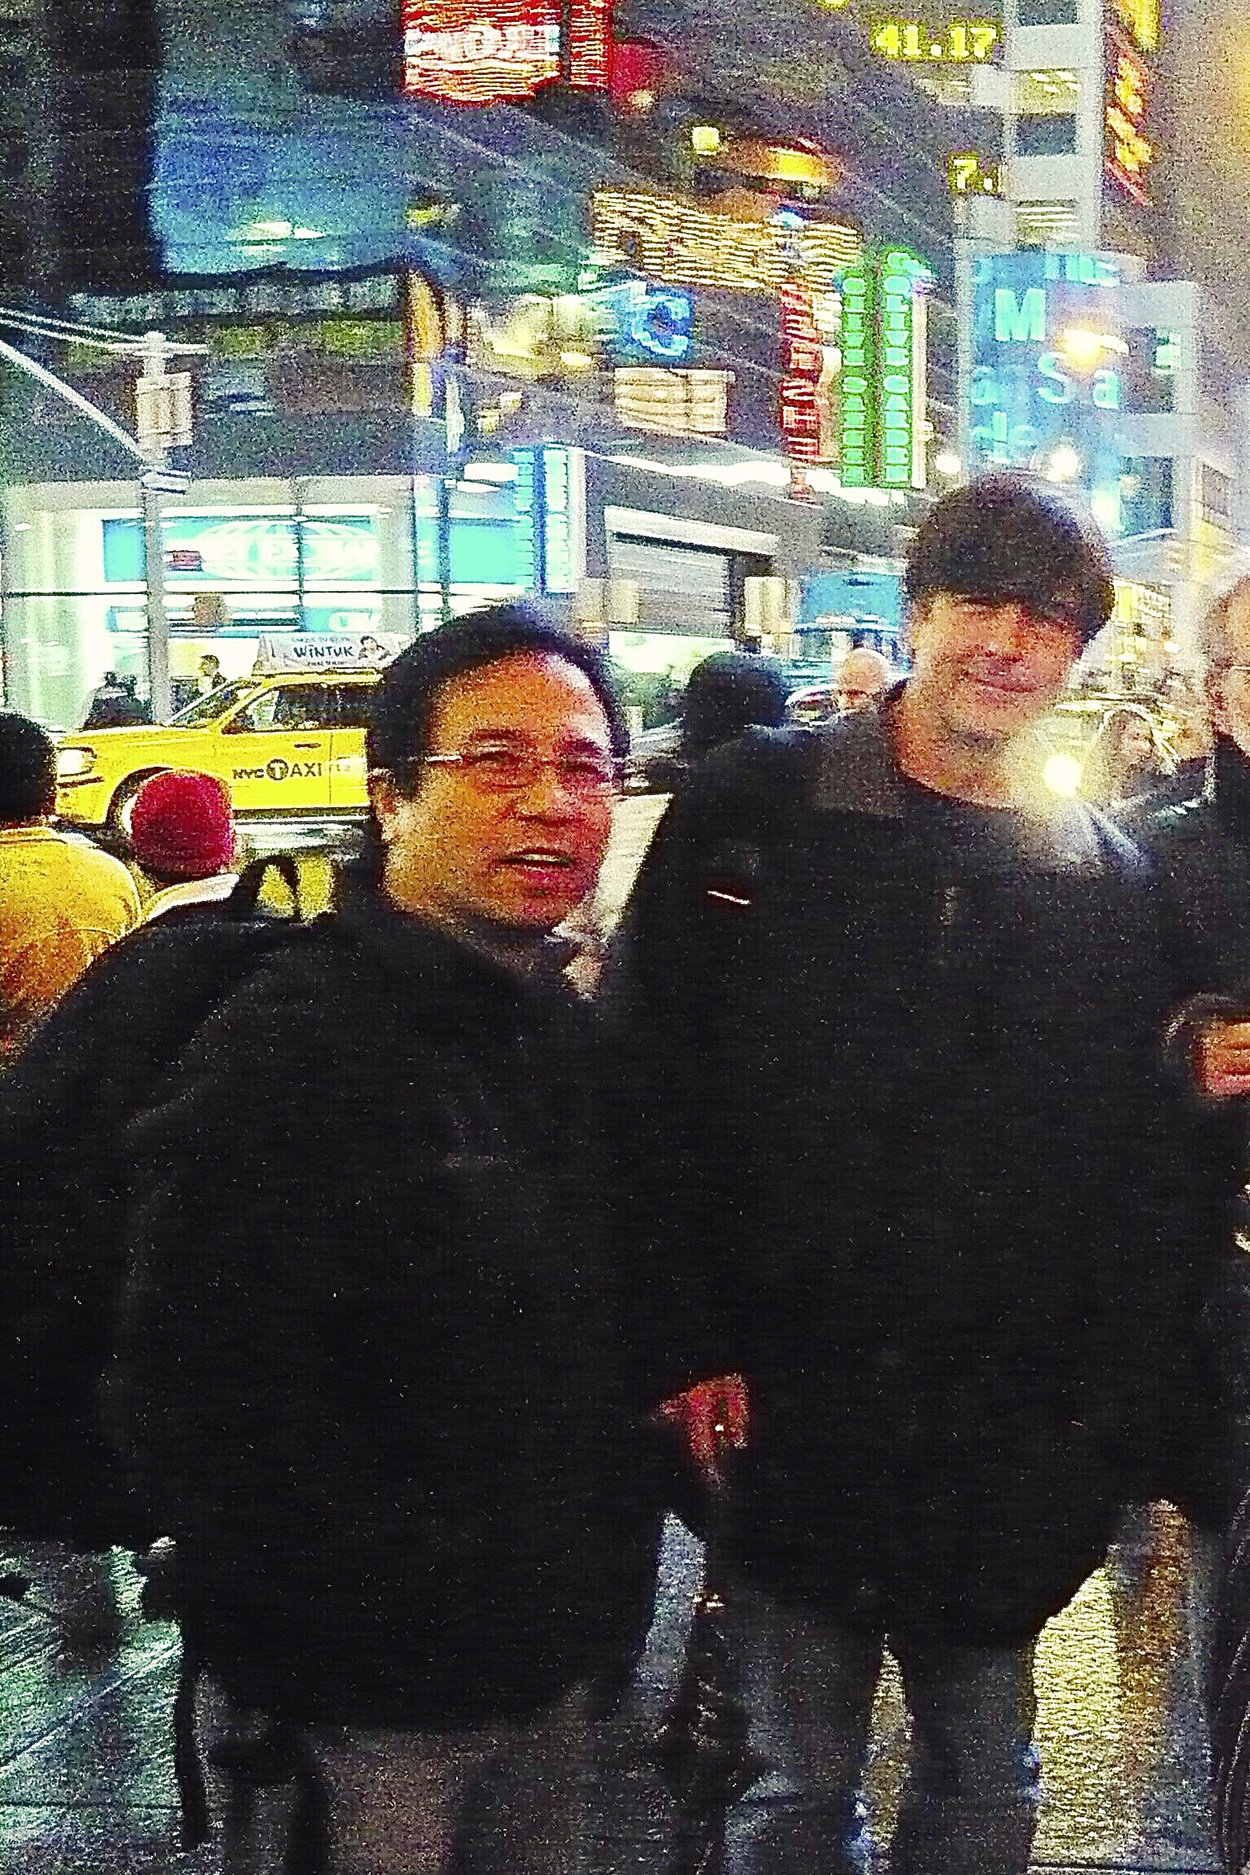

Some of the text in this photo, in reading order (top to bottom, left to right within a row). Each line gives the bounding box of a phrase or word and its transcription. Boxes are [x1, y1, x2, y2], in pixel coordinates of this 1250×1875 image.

[875, 24, 998, 58] 41.17
[882, 275, 911, 483] OLIVE GARDEN
[265, 758, 322, 781] TAXI
